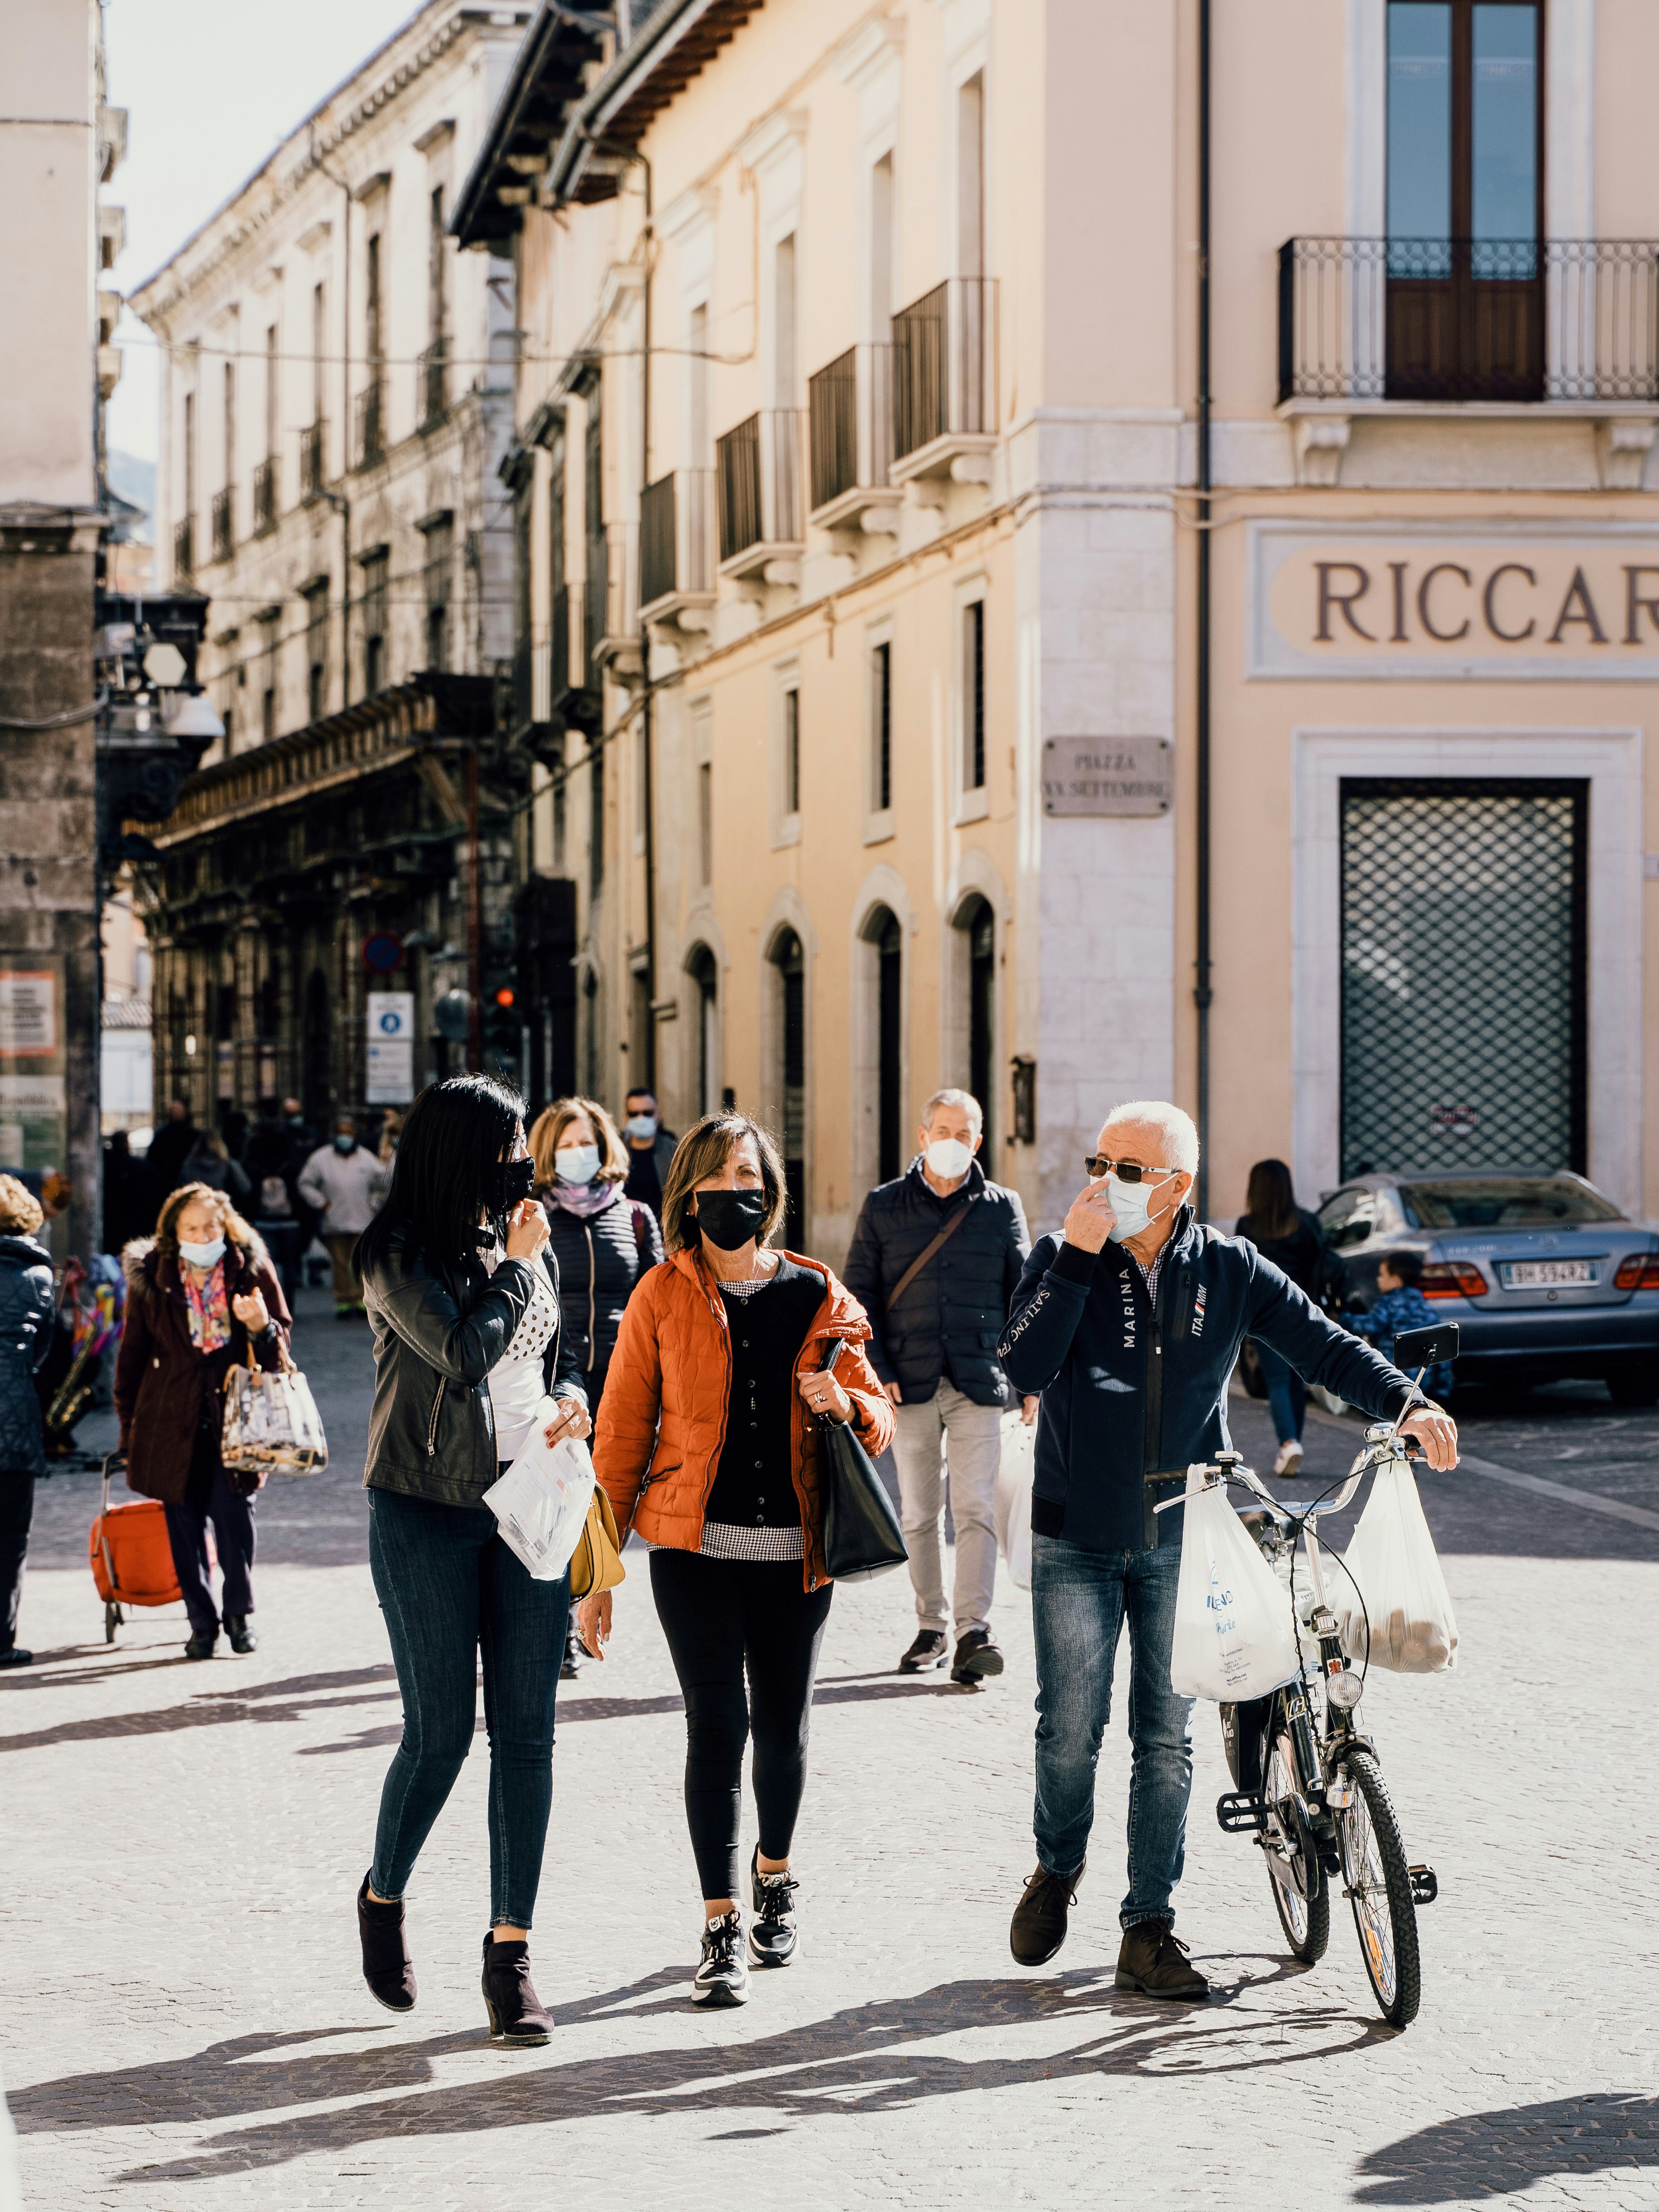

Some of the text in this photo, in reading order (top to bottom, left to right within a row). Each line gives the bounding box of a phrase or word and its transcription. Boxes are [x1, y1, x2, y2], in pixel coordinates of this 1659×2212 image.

[1074, 753, 1136, 770] PIAZZA
[1010, 1289, 1050, 1342] SAILING
[1119, 1268, 1135, 1348] MARINA
[1191, 1283, 1207, 1337] ITA MM
